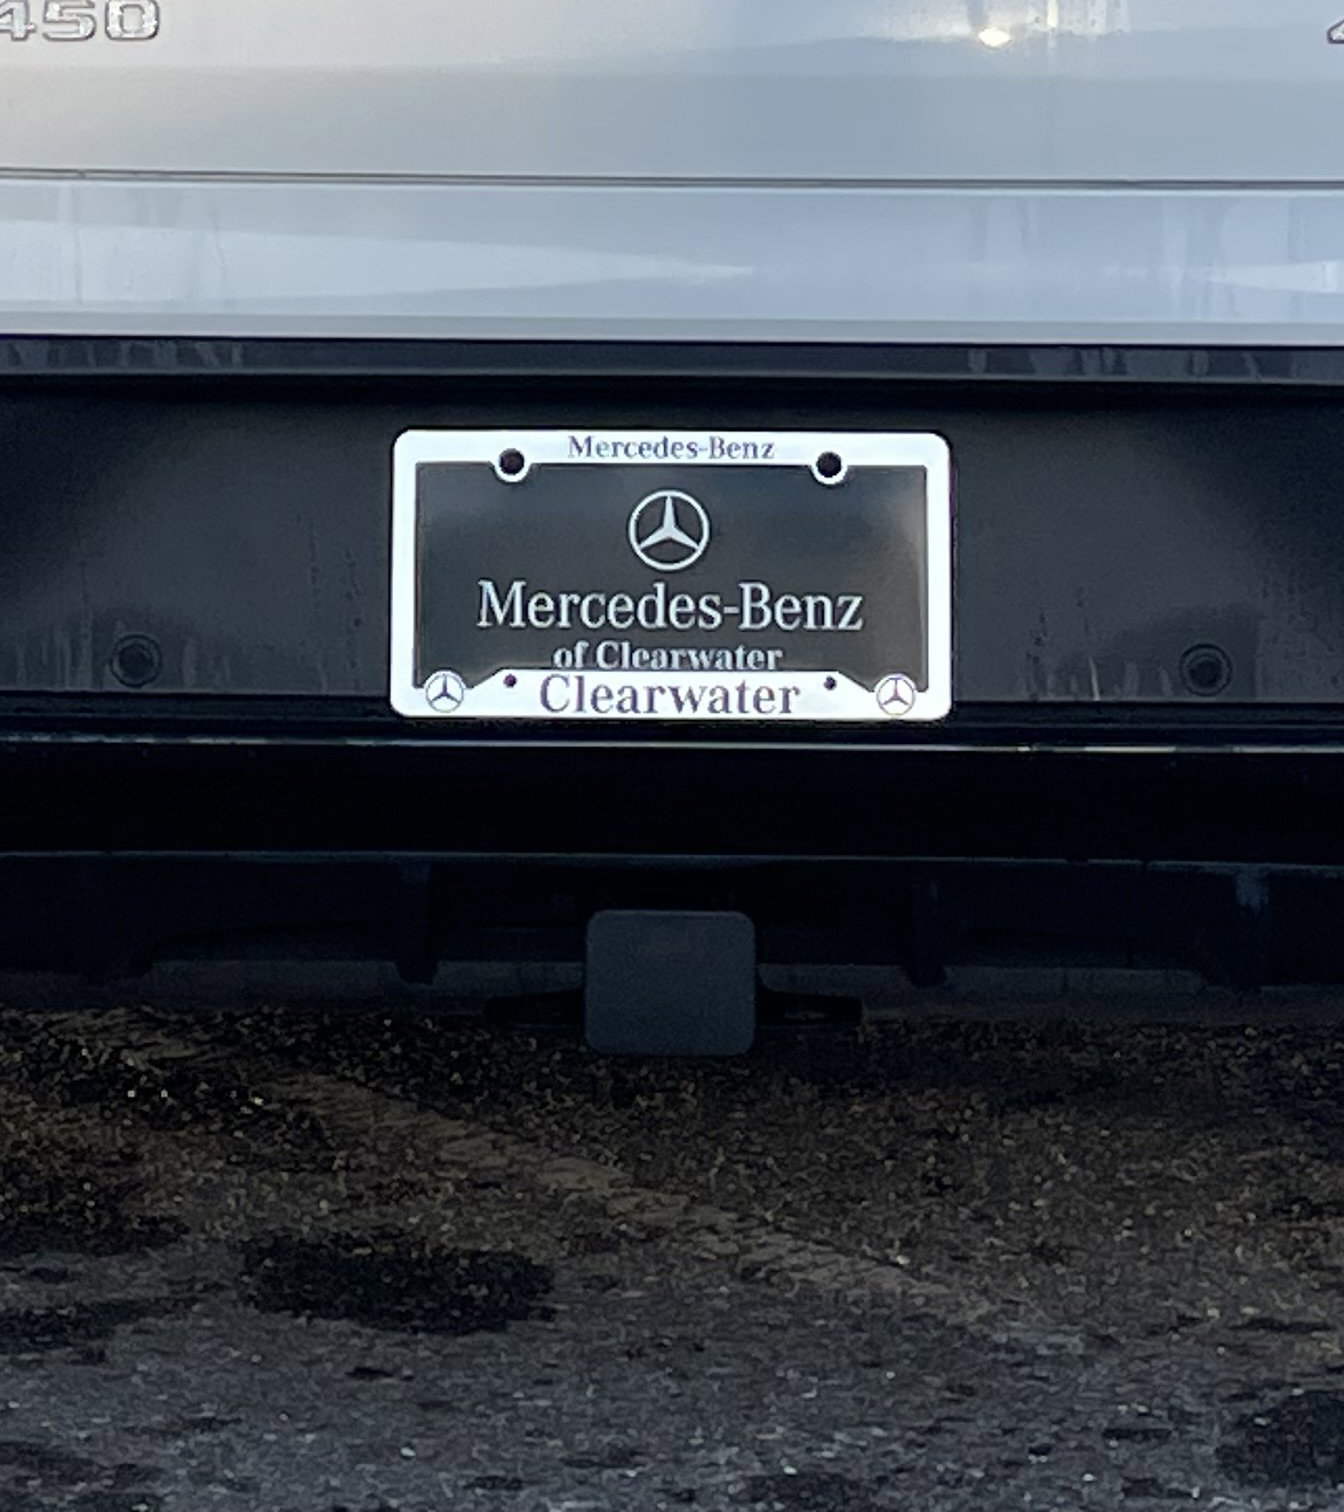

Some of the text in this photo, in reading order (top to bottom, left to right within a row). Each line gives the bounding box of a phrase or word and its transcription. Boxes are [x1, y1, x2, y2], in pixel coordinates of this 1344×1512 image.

[567, 435, 775, 461] Mercedes-Benz
[476, 579, 864, 632] Mercedes-Benz
[552, 640, 783, 671] of Clearwater
[539, 674, 801, 715] Clearwater
